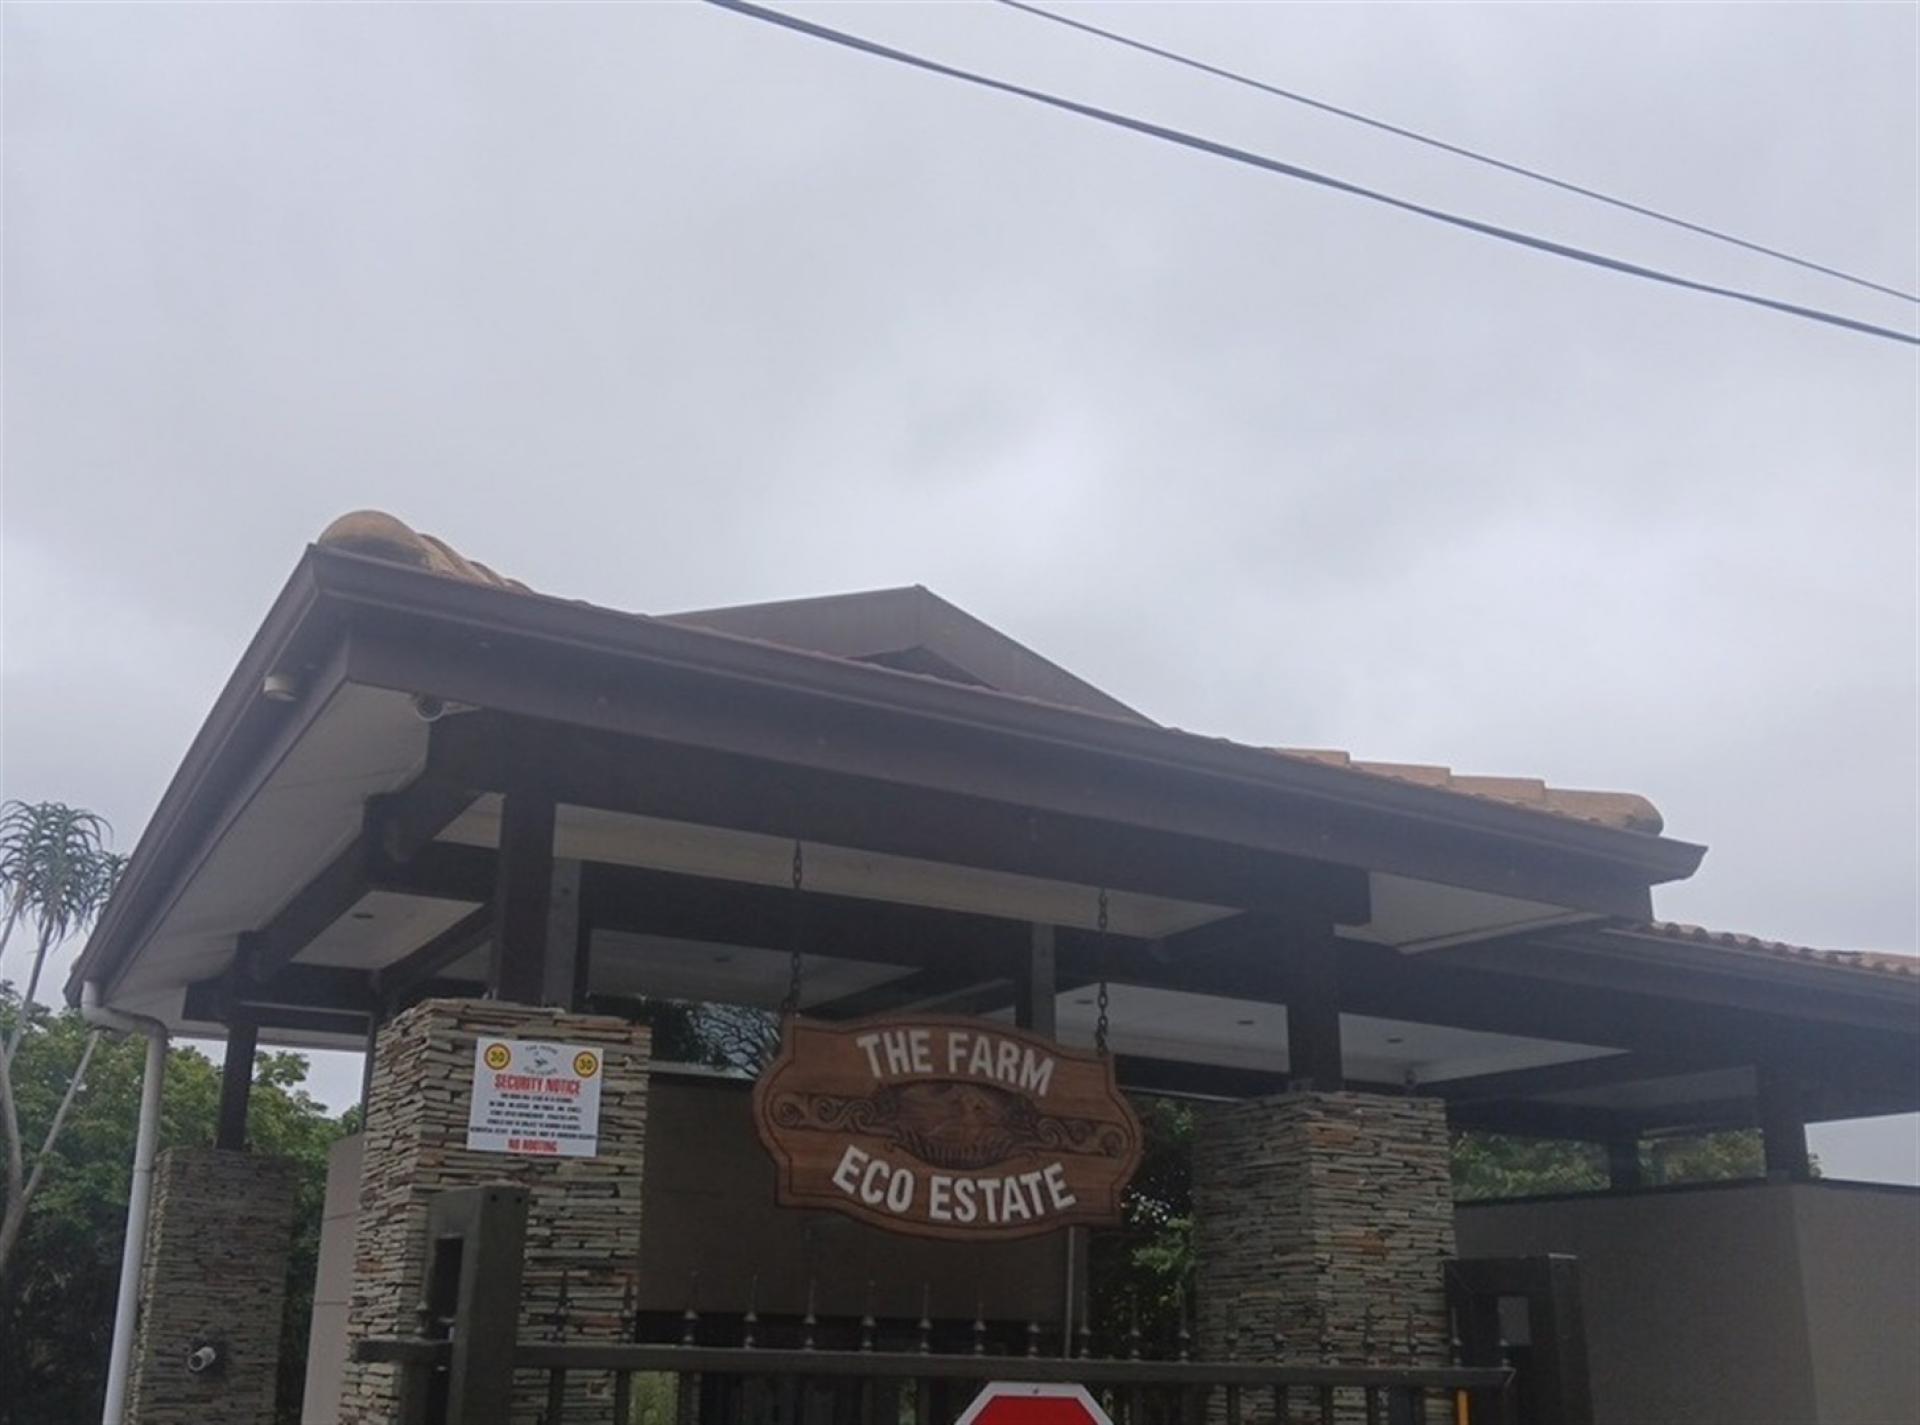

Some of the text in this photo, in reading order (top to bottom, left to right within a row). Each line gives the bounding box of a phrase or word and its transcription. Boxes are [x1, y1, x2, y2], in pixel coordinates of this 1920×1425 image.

[494, 1073, 581, 1095] SECURITY NOTICE
[857, 1030, 1055, 1096] THE FARM
[508, 1138, 520, 1150] NO
[832, 1145, 1077, 1222] ECO ESTATE
